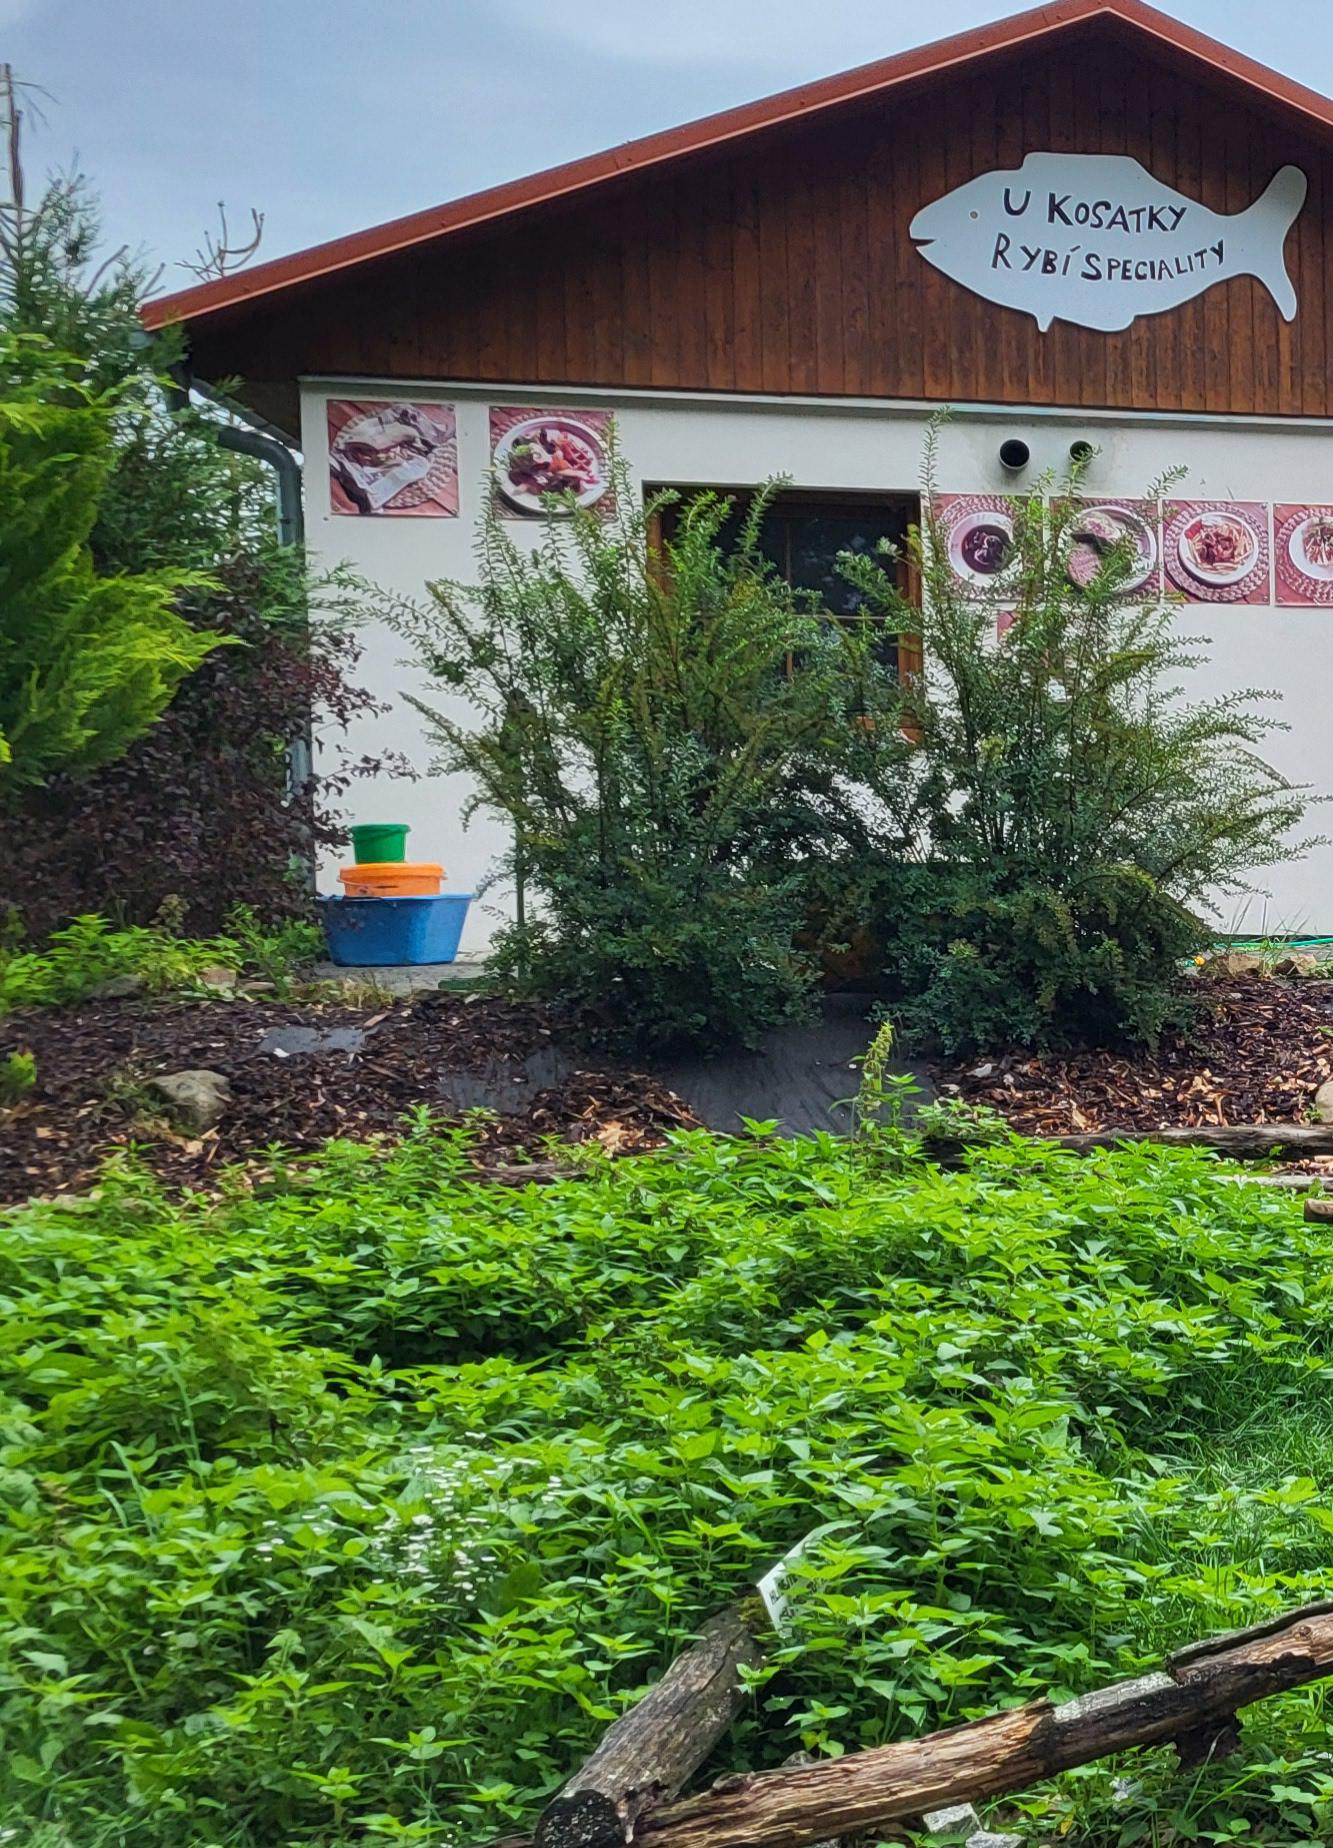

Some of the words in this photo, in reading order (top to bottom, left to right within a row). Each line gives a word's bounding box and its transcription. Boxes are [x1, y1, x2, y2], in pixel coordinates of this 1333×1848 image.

[1003, 188, 1031, 215] U
[1048, 192, 1187, 233] KOSATKY
[991, 233, 1081, 276] RYBÍ
[1081, 239, 1226, 281] SPECIALITY
